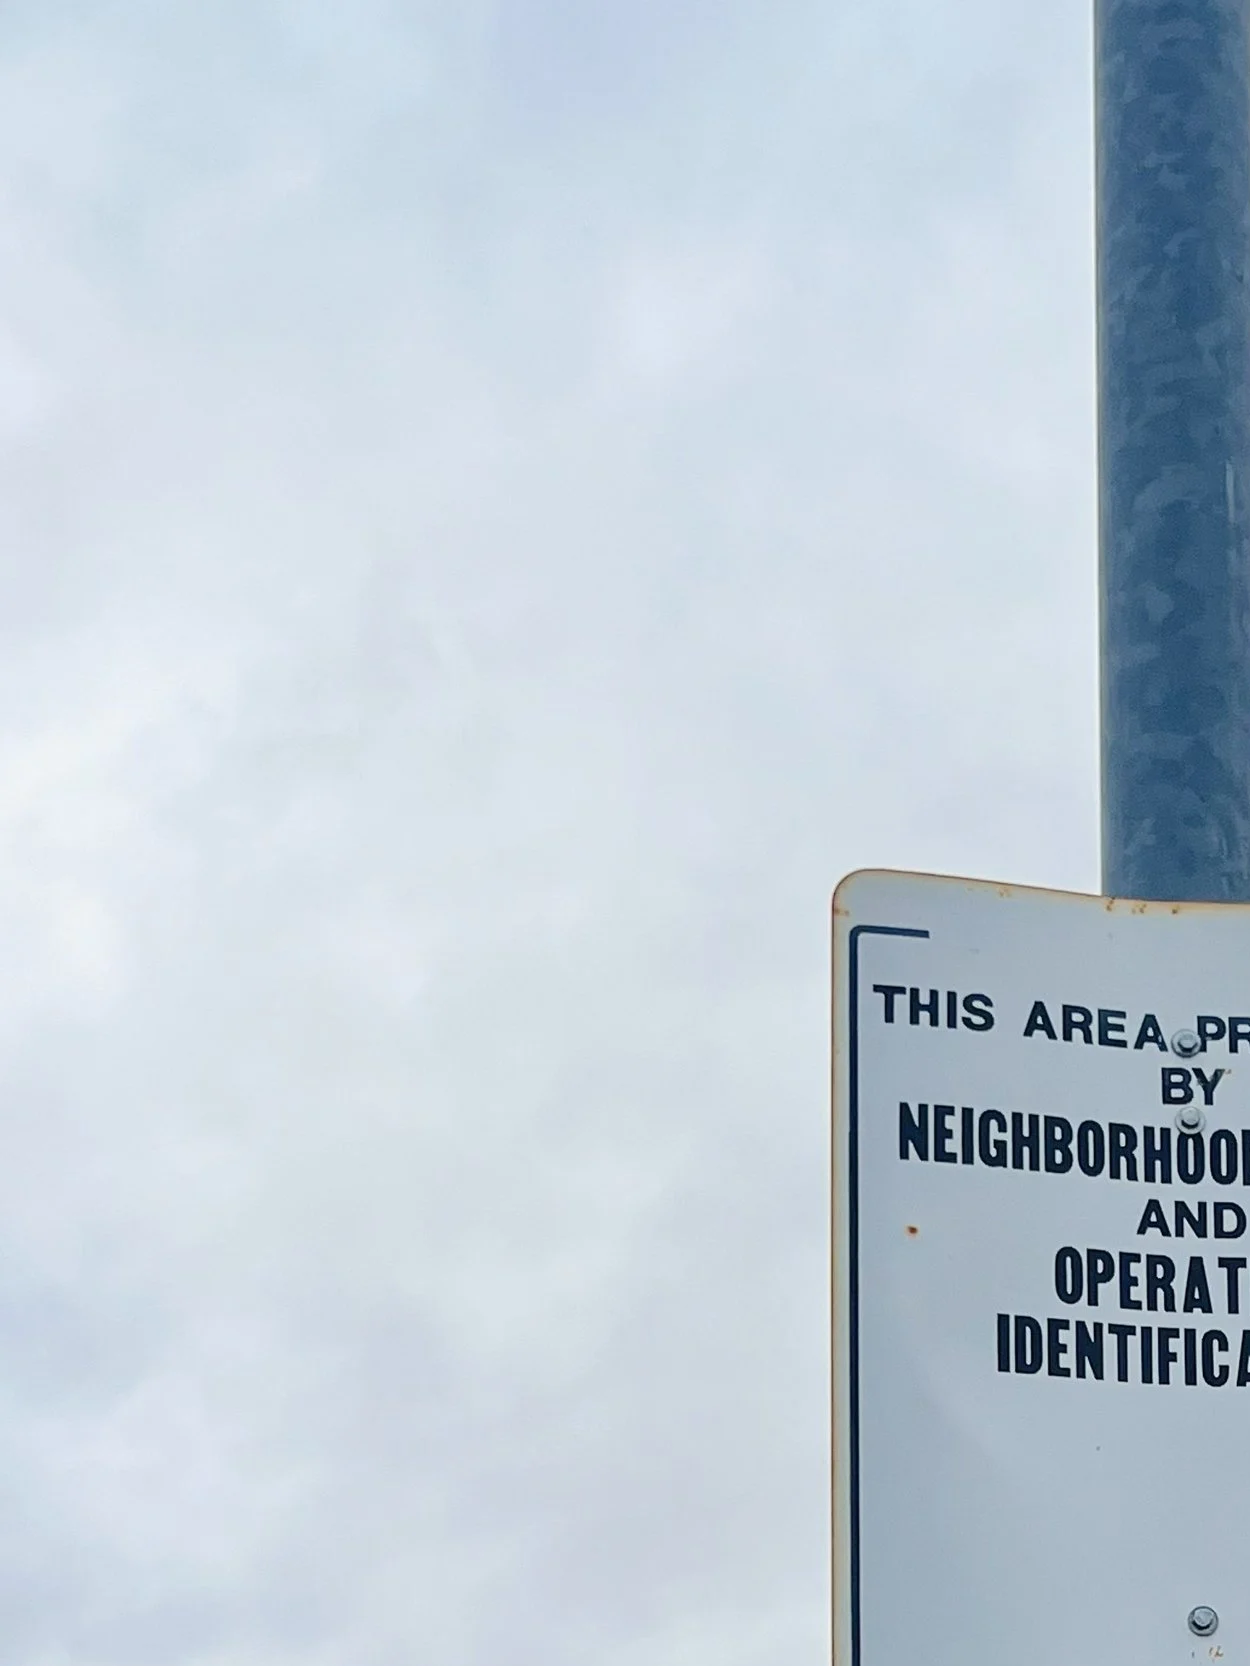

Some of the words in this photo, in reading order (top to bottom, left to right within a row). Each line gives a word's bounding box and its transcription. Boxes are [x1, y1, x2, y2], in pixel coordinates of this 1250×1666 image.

[872, 983, 995, 1032] THIS
[1022, 1000, 1169, 1053] AREA
[1161, 1067, 1226, 1106] BY
[1136, 1198, 1247, 1239] AND
